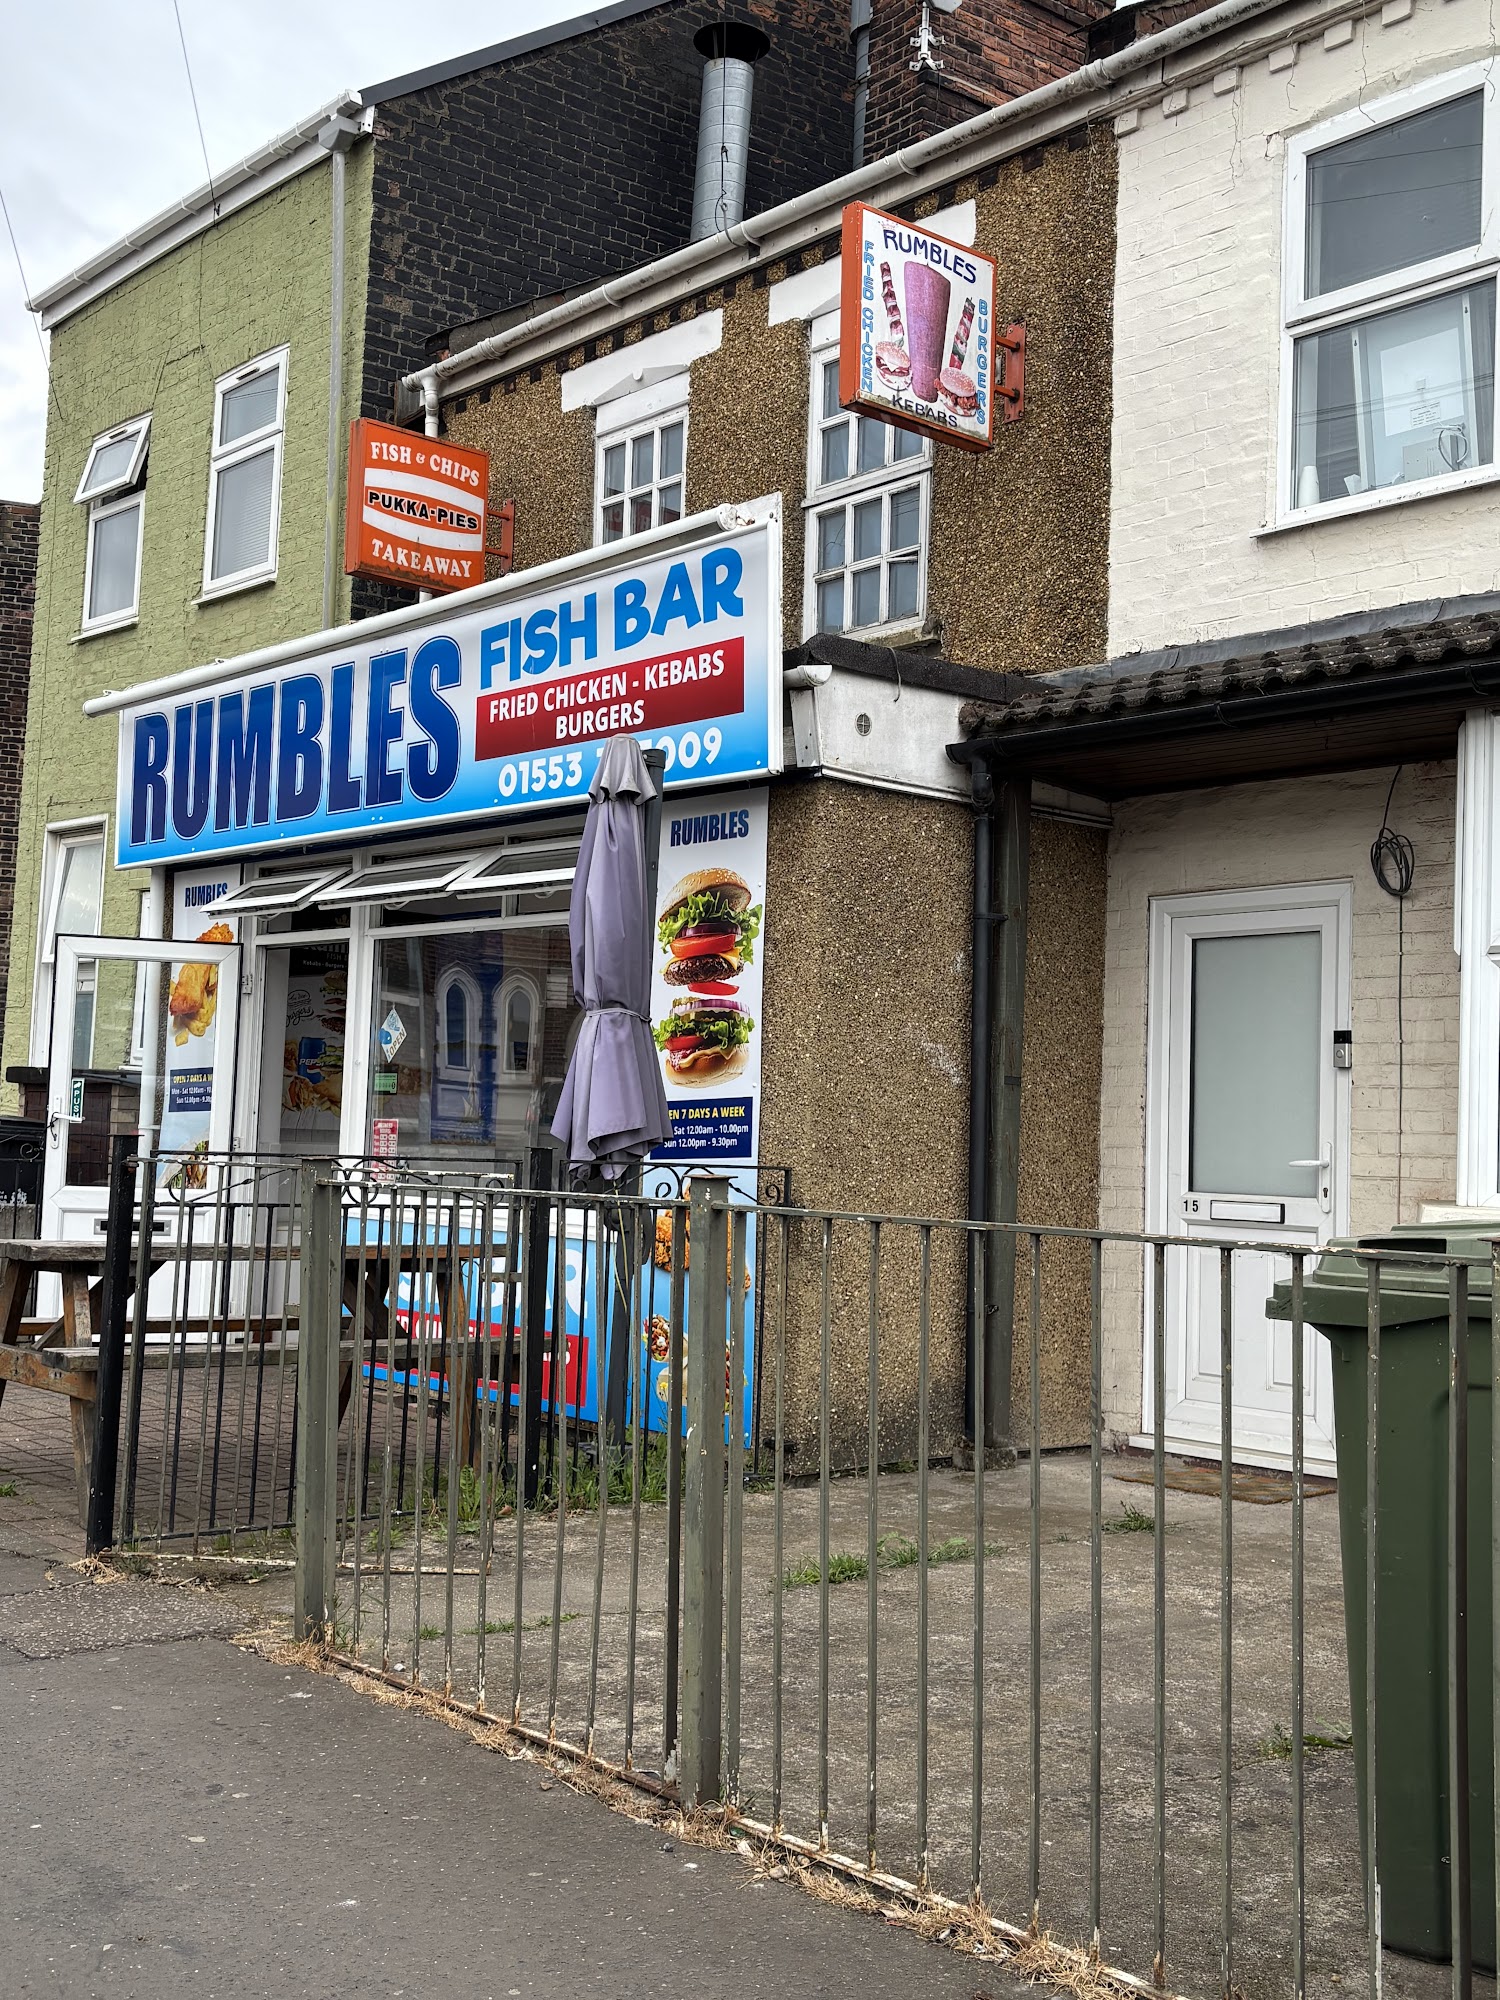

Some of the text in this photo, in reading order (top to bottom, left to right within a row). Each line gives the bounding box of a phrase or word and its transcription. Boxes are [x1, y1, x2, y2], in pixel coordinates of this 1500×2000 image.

[882, 229, 977, 284] RUMBLES
[861, 240, 875, 393] FRIED CHICKEN
[976, 298, 988, 425] BURGERS
[891, 394, 958, 428] KEBABS
[370, 441, 480, 487] FISH & CHIPS
[368, 490, 479, 531] PUKKA-PIES
[371, 538, 472, 578] TAKEAWAY
[480, 546, 744, 691] FISH BAR
[489, 692, 539, 723] FRIED
[543, 671, 627, 712] CHICKEN
[644, 649, 725, 692] KEBABS
[555, 700, 645, 740] BURGERS
[129, 635, 462, 847] RUMBLES
[498, 751, 583, 798] 01553
[670, 809, 750, 848] RUMBLES
[389, 1027, 406, 1057] OPEN
[673, 1126, 685, 1136] Sat
[719, 1124, 749, 1136] 10.00pm
[681, 1108, 686, 1120] 7
[688, 1107, 711, 1120] DAYS
[711, 1107, 719, 1118] A
[720, 1106, 745, 1117] WEEK
[678, 1138, 707, 1150] 12.00pm
[711, 1137, 738, 1149] 9.30pm
[1183, 1199, 1199, 1212] 15
